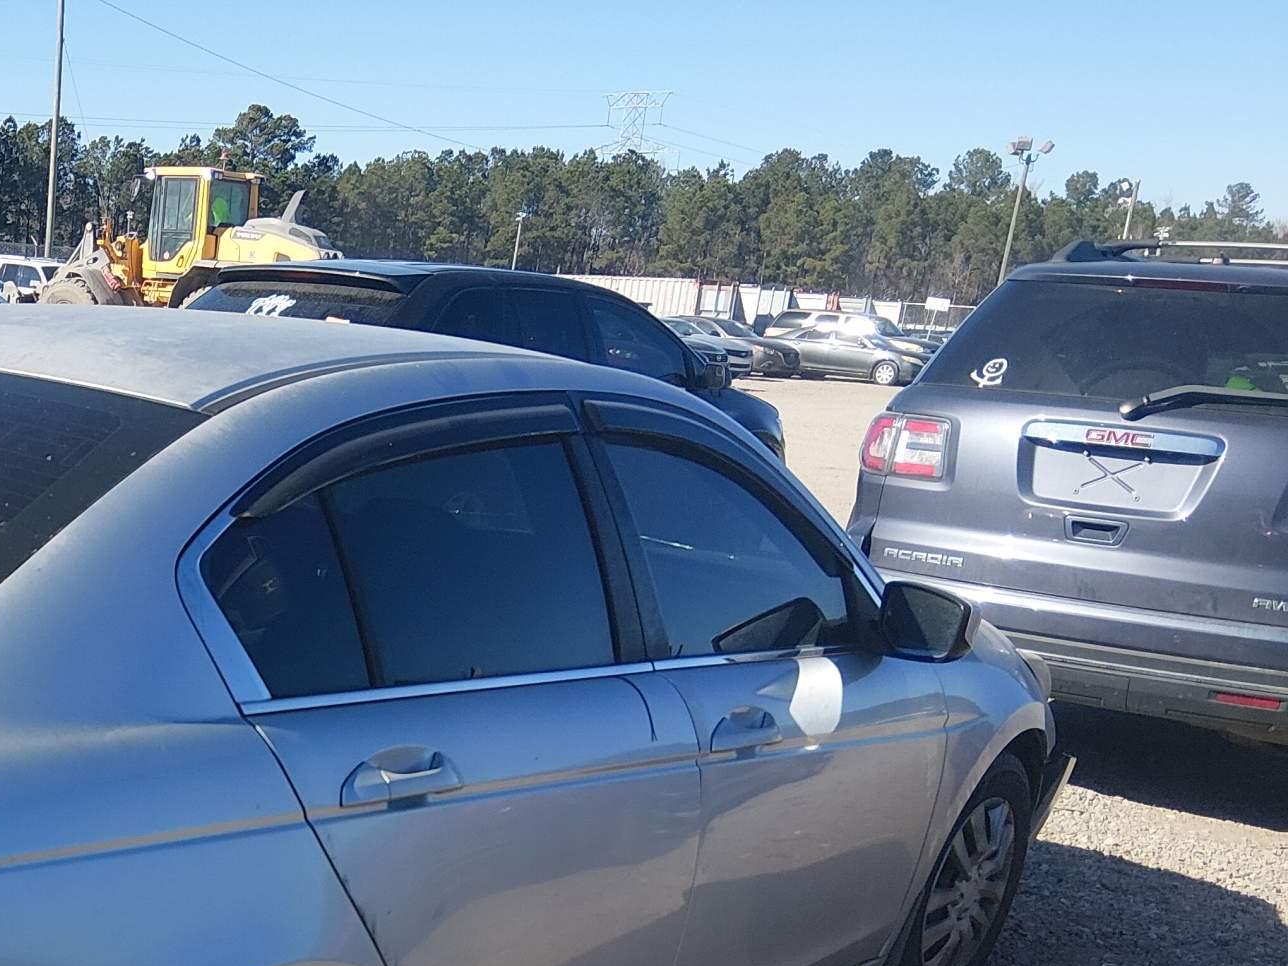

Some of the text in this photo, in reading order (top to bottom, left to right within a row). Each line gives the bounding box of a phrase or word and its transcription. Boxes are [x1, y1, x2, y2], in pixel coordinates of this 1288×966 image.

[1085, 428, 1155, 448] GMC
[882, 547, 964, 567] ACADIA
[1252, 597, 1288, 612] AW
